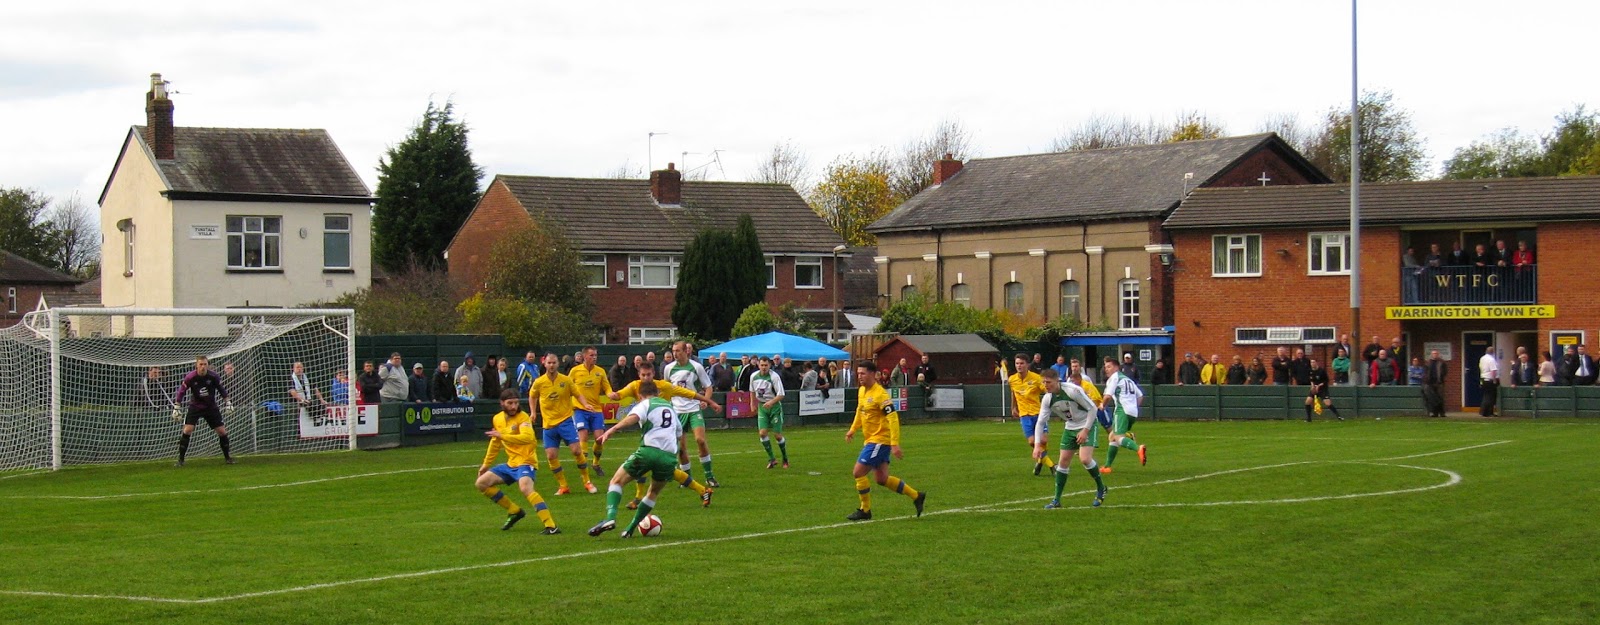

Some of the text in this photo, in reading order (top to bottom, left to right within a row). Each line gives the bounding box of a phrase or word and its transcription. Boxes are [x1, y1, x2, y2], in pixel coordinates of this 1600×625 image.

[1435, 274, 1499, 287] WTFC
[1391, 307, 1550, 318] WARRINGTON TOWN FC.
[1124, 379, 1136, 394] 10
[313, 406, 367, 427] DANE
[432, 407, 465, 415] DISTRIBUTION
[661, 408, 672, 428] 8
